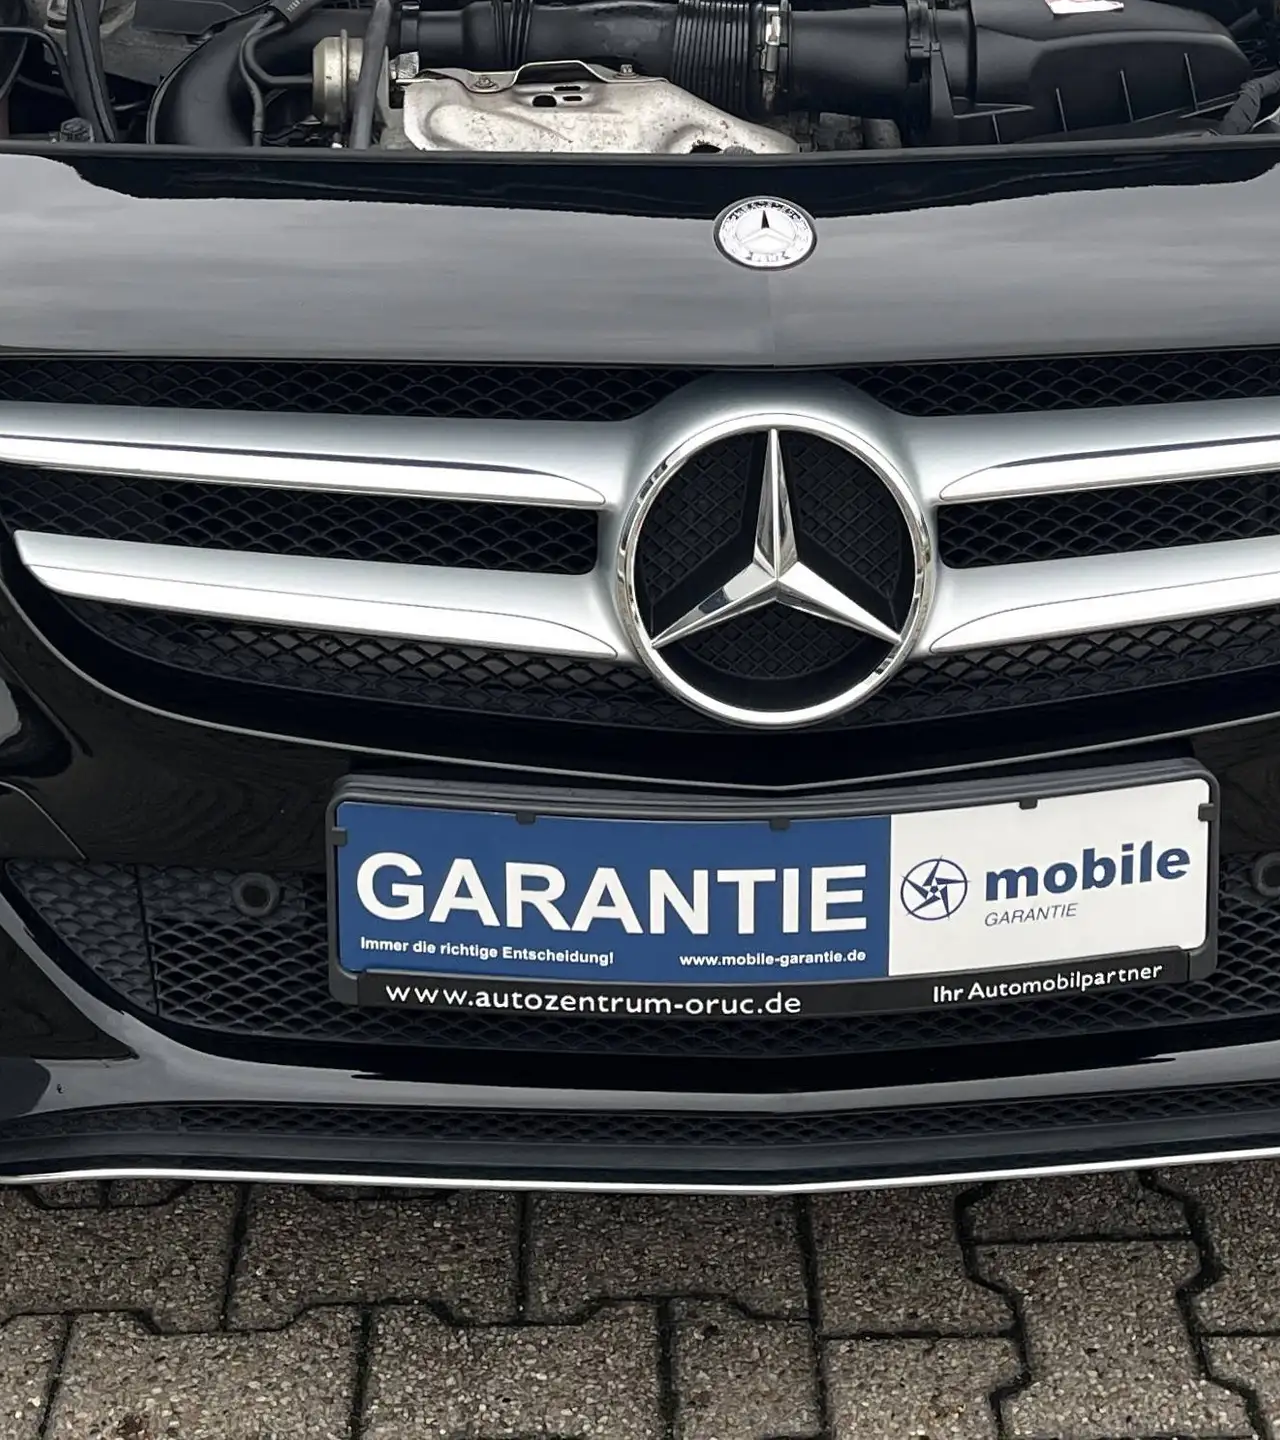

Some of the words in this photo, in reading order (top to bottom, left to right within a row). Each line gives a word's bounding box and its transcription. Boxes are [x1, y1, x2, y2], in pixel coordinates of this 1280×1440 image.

[985, 840, 1191, 902] mobile
[356, 851, 867, 935] GARANTIE
[984, 903, 1079, 927] GARANTIE
[360, 936, 409, 953] Immer
[412, 940, 436, 955] die
[440, 942, 499, 961] richtige
[502, 946, 614, 966] Entscheidung!
[679, 949, 867, 968] www.mobile-garantie.de
[933, 985, 964, 1003] Ihr
[967, 964, 1163, 1000] Automobilpartner
[385, 984, 802, 1015] www.autozentrum-oruc.de
